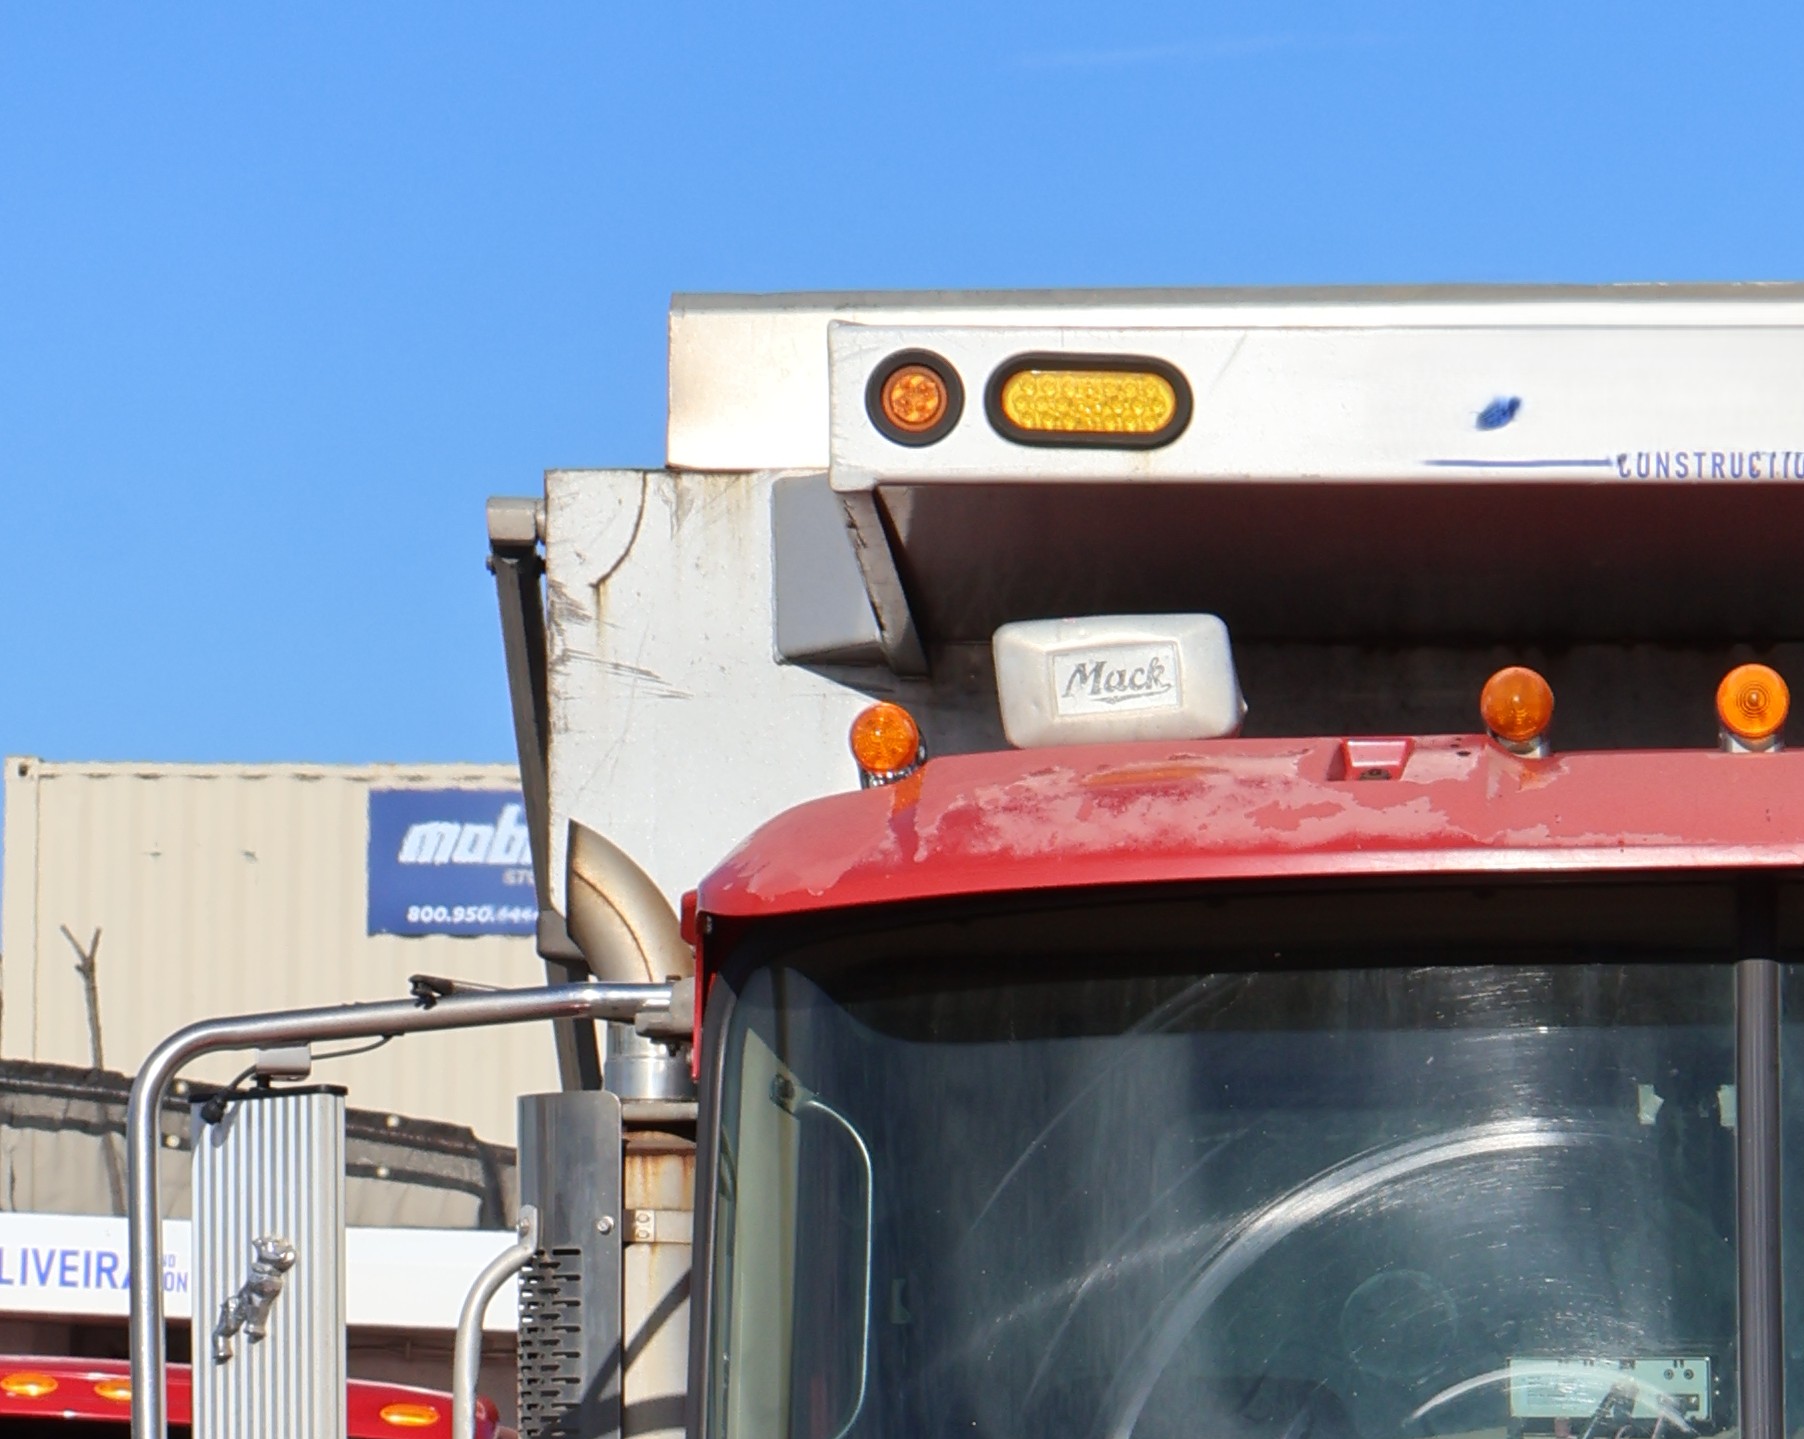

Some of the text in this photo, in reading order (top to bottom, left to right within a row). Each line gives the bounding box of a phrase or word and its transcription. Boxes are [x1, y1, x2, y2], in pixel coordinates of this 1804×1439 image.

[1061, 655, 1173, 700] Mack
[0, 1246, 130, 1290] LIVEIR
[162, 1271, 189, 1293] ON
